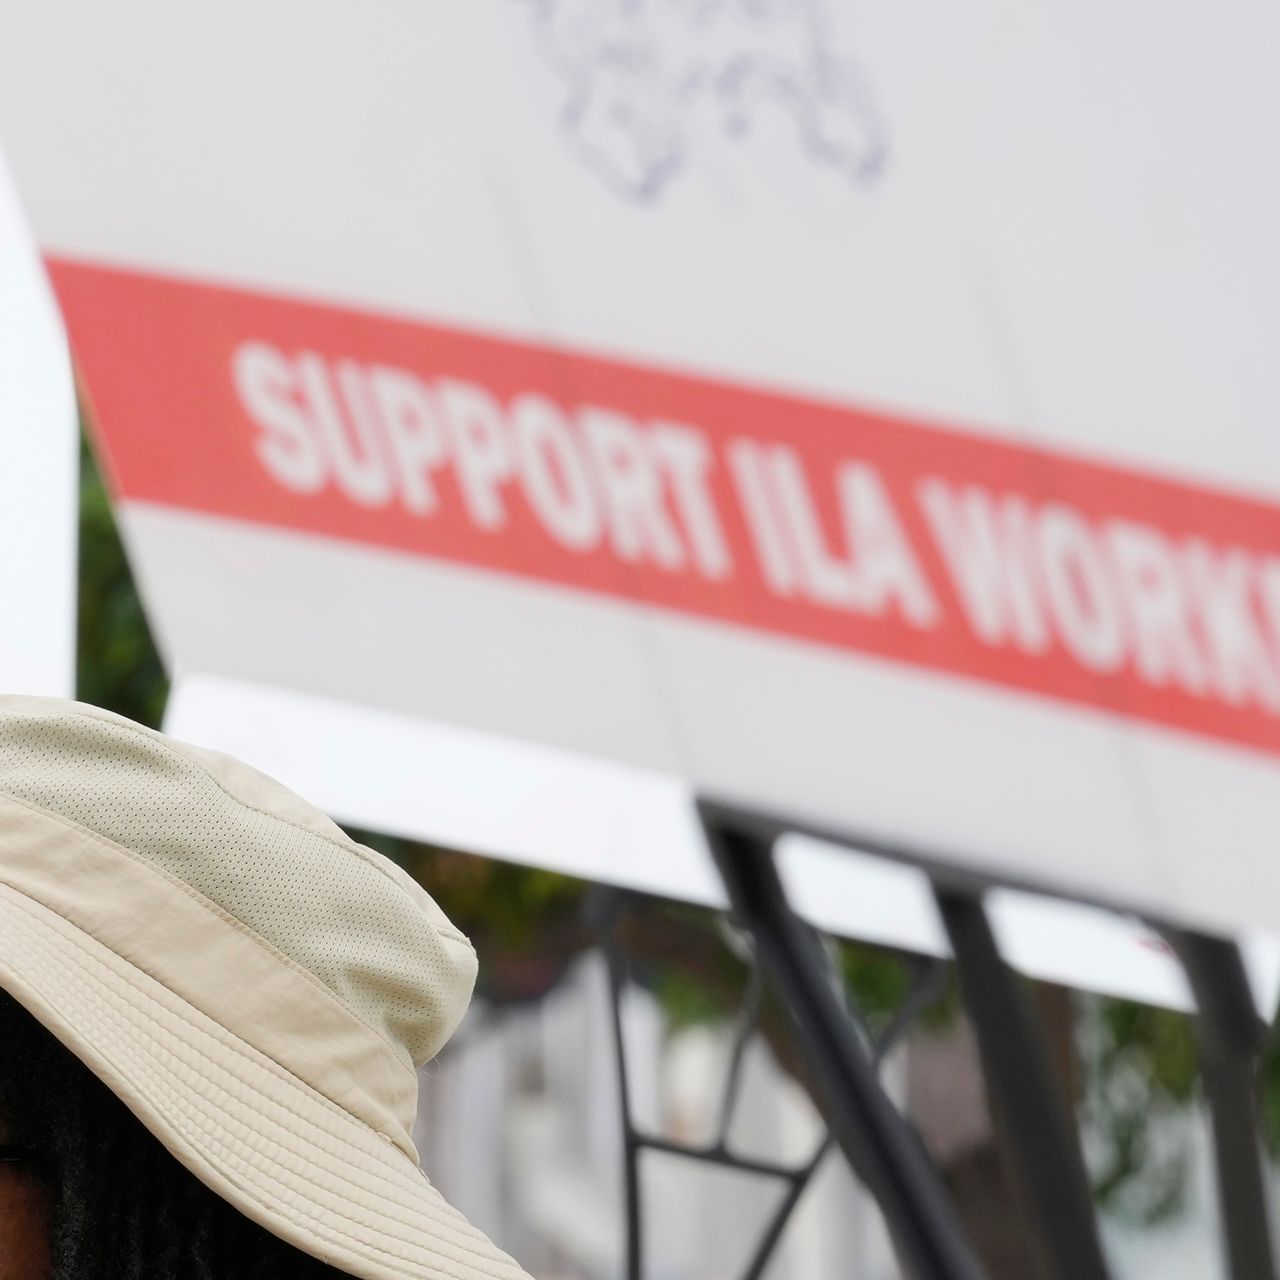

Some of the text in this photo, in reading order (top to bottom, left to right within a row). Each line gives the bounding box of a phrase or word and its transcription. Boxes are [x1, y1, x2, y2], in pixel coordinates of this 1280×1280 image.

[232, 339, 1280, 718] SUPPORT ILA WORK
